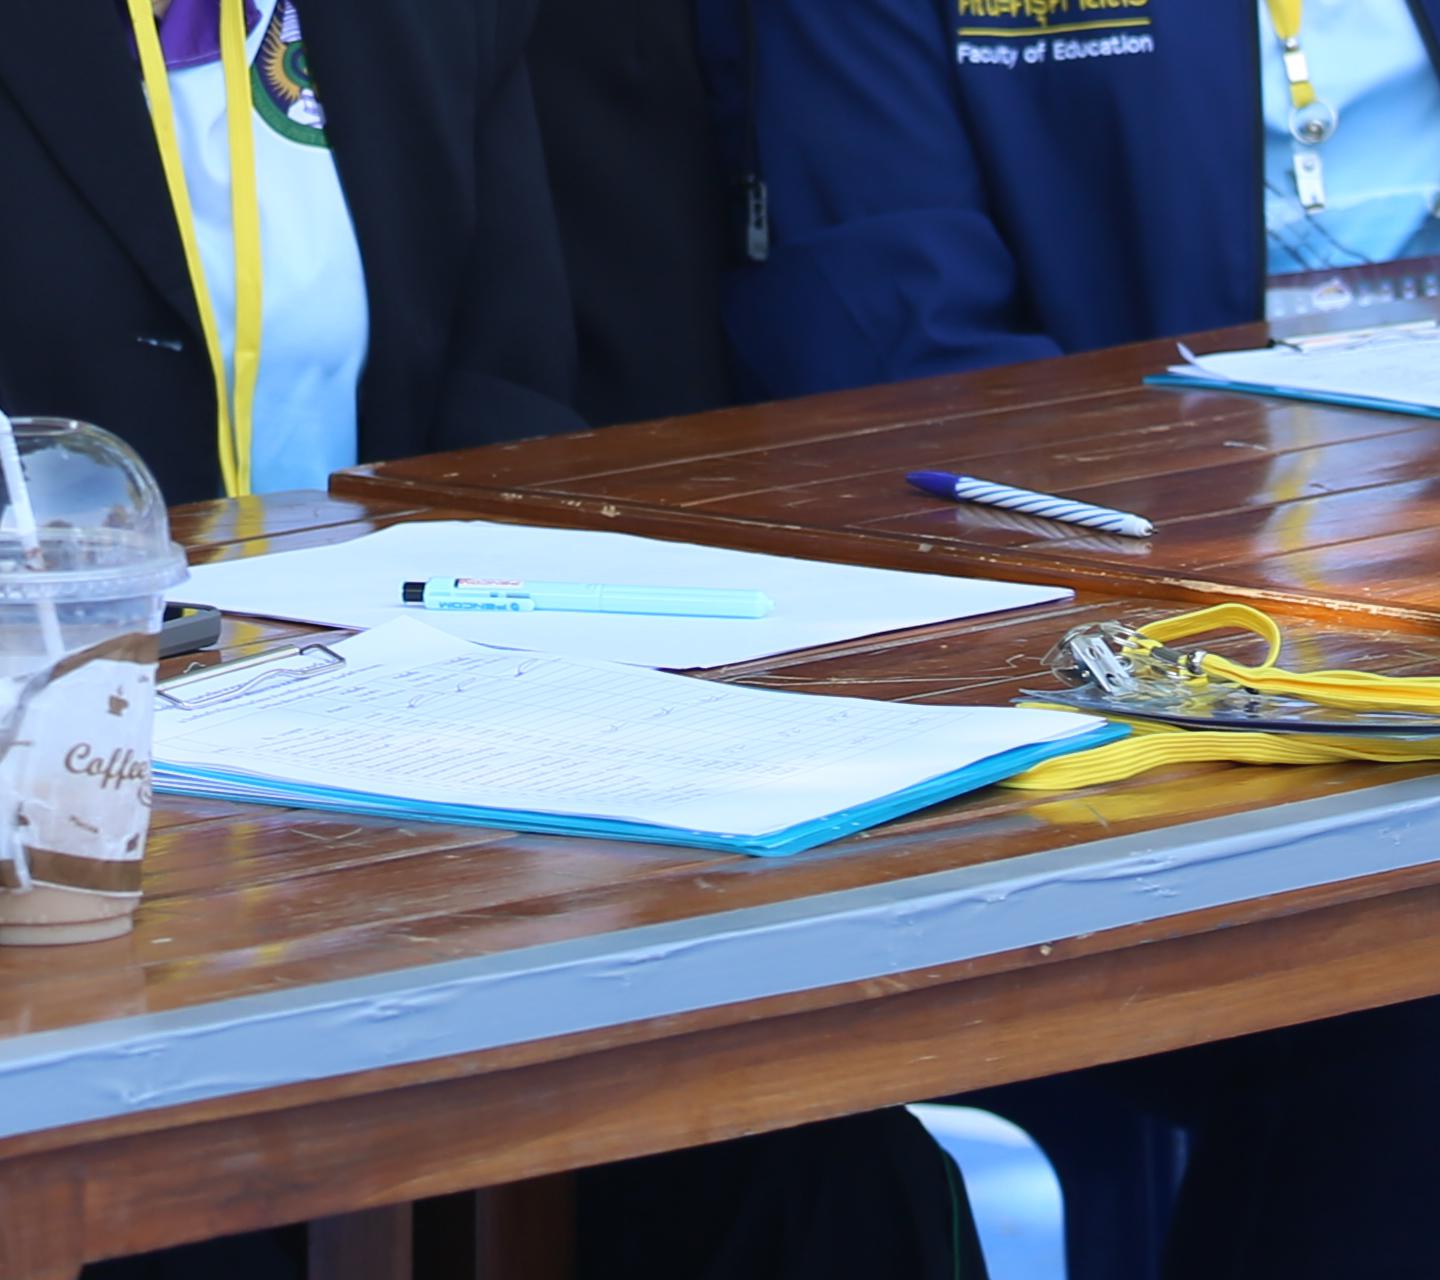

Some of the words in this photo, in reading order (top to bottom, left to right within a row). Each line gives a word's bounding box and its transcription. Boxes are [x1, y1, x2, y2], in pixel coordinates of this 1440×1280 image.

[956, 41, 1018, 69] Faculty
[1023, 40, 1046, 64] of
[1052, 34, 1154, 61] Education
[64, 742, 148, 790] Coffee
